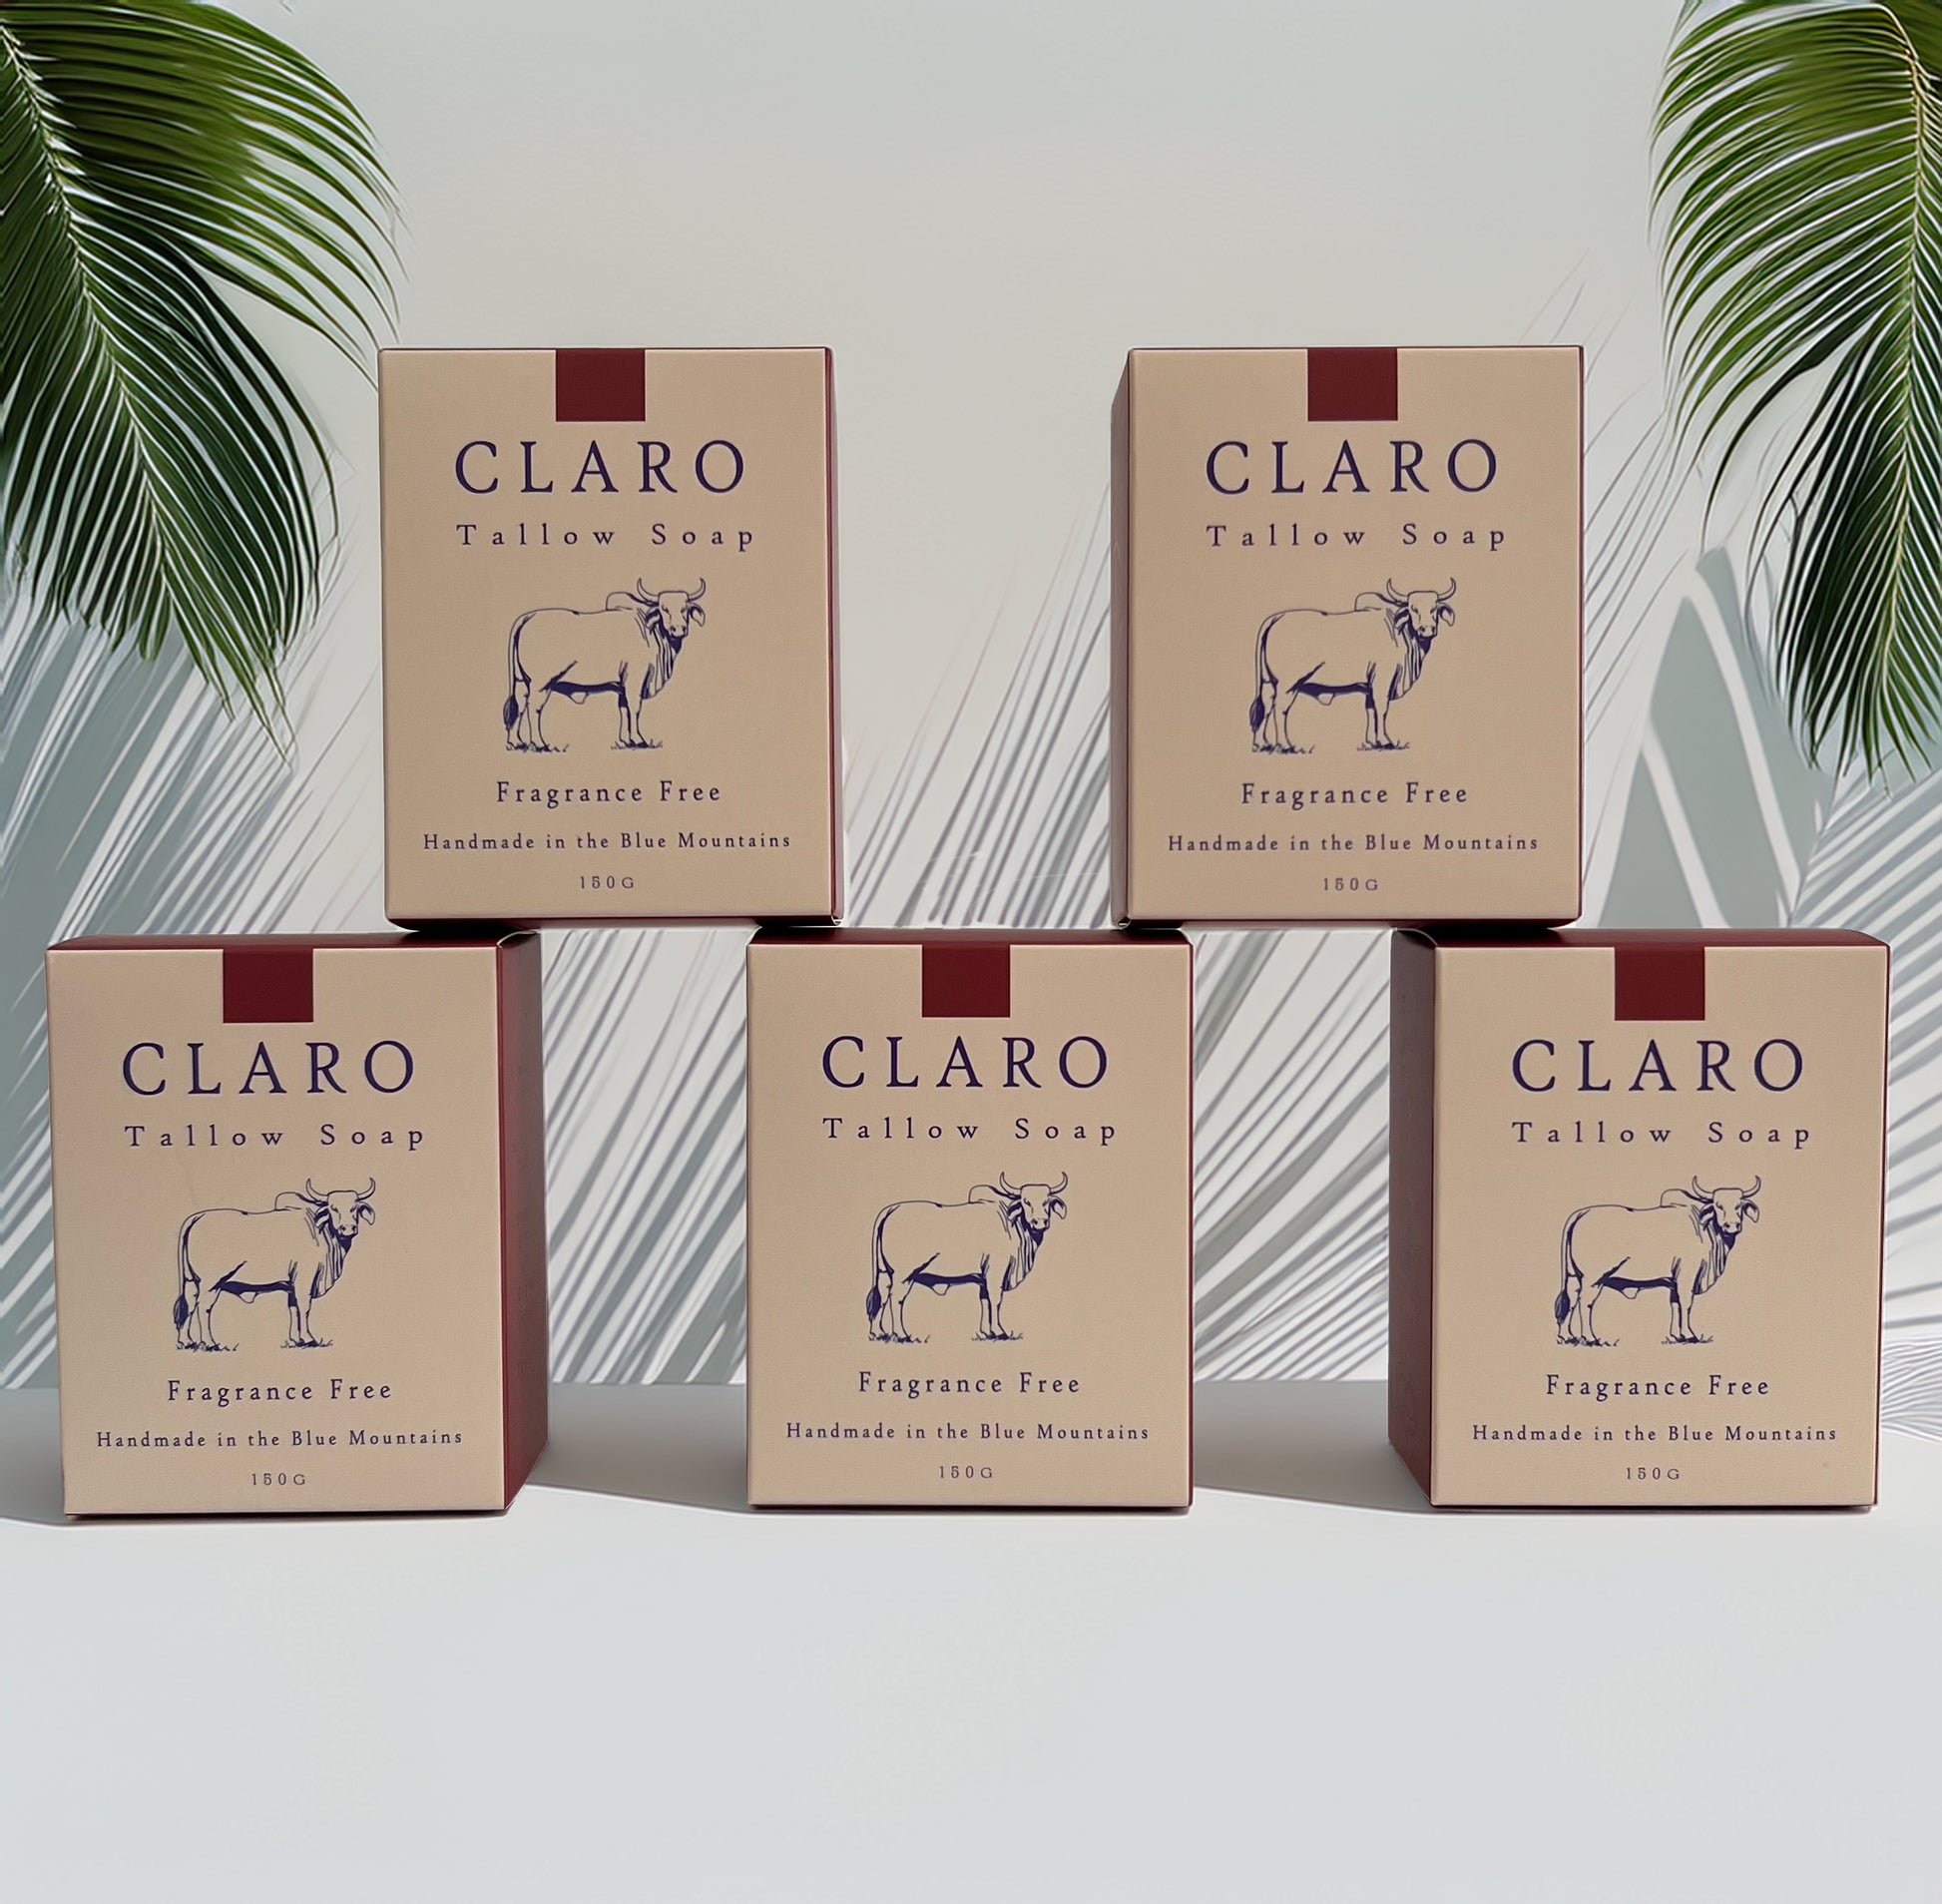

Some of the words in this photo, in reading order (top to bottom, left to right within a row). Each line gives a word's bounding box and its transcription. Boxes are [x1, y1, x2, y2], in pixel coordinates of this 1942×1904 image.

[456, 440, 743, 493] CLARO
[1207, 439, 1496, 494] CLARO
[456, 523, 614, 545] Tallow
[653, 524, 751, 552] Soap
[1207, 523, 1365, 546] Tallow
[1403, 524, 1504, 551] Soap
[497, 781, 641, 808] Fragrance
[661, 780, 720, 800] Free
[1242, 783, 1387, 810] Fragrance
[1406, 782, 1466, 802] Free
[424, 833, 534, 849] Handmade
[547, 834, 564, 848] in
[578, 832, 608, 848] the
[622, 832, 665, 847] Blue
[679, 832, 789, 847] Mountains
[1169, 834, 1277, 850] Handmade
[1291, 836, 1308, 850] in
[1322, 834, 1352, 850] the
[1366, 834, 1410, 850] Blue
[1424, 834, 1537, 849] Mountains
[581, 876, 634, 888] 150G
[1324, 878, 1377, 890] 150G
[123, 1041, 413, 1095] CLARO
[823, 1036, 1107, 1088] CLARO
[1513, 1039, 1802, 1092] CLARO
[125, 1125, 282, 1146] Tallow
[321, 1125, 422, 1151] Soap
[823, 1117, 978, 1139] Tallow
[1015, 1119, 1114, 1146] Soap
[1512, 1121, 1671, 1143] Tallow
[1708, 1122, 1808, 1150] Soap
[169, 1380, 311, 1407] Fragrance
[330, 1379, 390, 1399] Free
[859, 1371, 1001, 1399] Fragrance
[1020, 1372, 1078, 1392] Free
[1547, 1374, 1691, 1402] Fragrance
[1709, 1375, 1767, 1395] Free
[98, 1431, 205, 1446] Handmade
[219, 1433, 236, 1446] in
[248, 1431, 279, 1446] the
[292, 1430, 336, 1445] Blue
[349, 1430, 461, 1445] Mountains
[787, 1422, 894, 1438] Handmade
[907, 1424, 925, 1438] in
[938, 1423, 967, 1438] the
[981, 1423, 1024, 1438] Blue
[1038, 1424, 1148, 1439] Mountains
[1473, 1425, 1581, 1440] Handmade
[1595, 1427, 1613, 1440] in
[1626, 1425, 1656, 1440] the
[1669, 1425, 1712, 1440] Blue
[1725, 1426, 1835, 1440] Mountains
[252, 1473, 304, 1485] 150G
[940, 1466, 992, 1478] 150G
[1627, 1467, 1679, 1480] 150G
